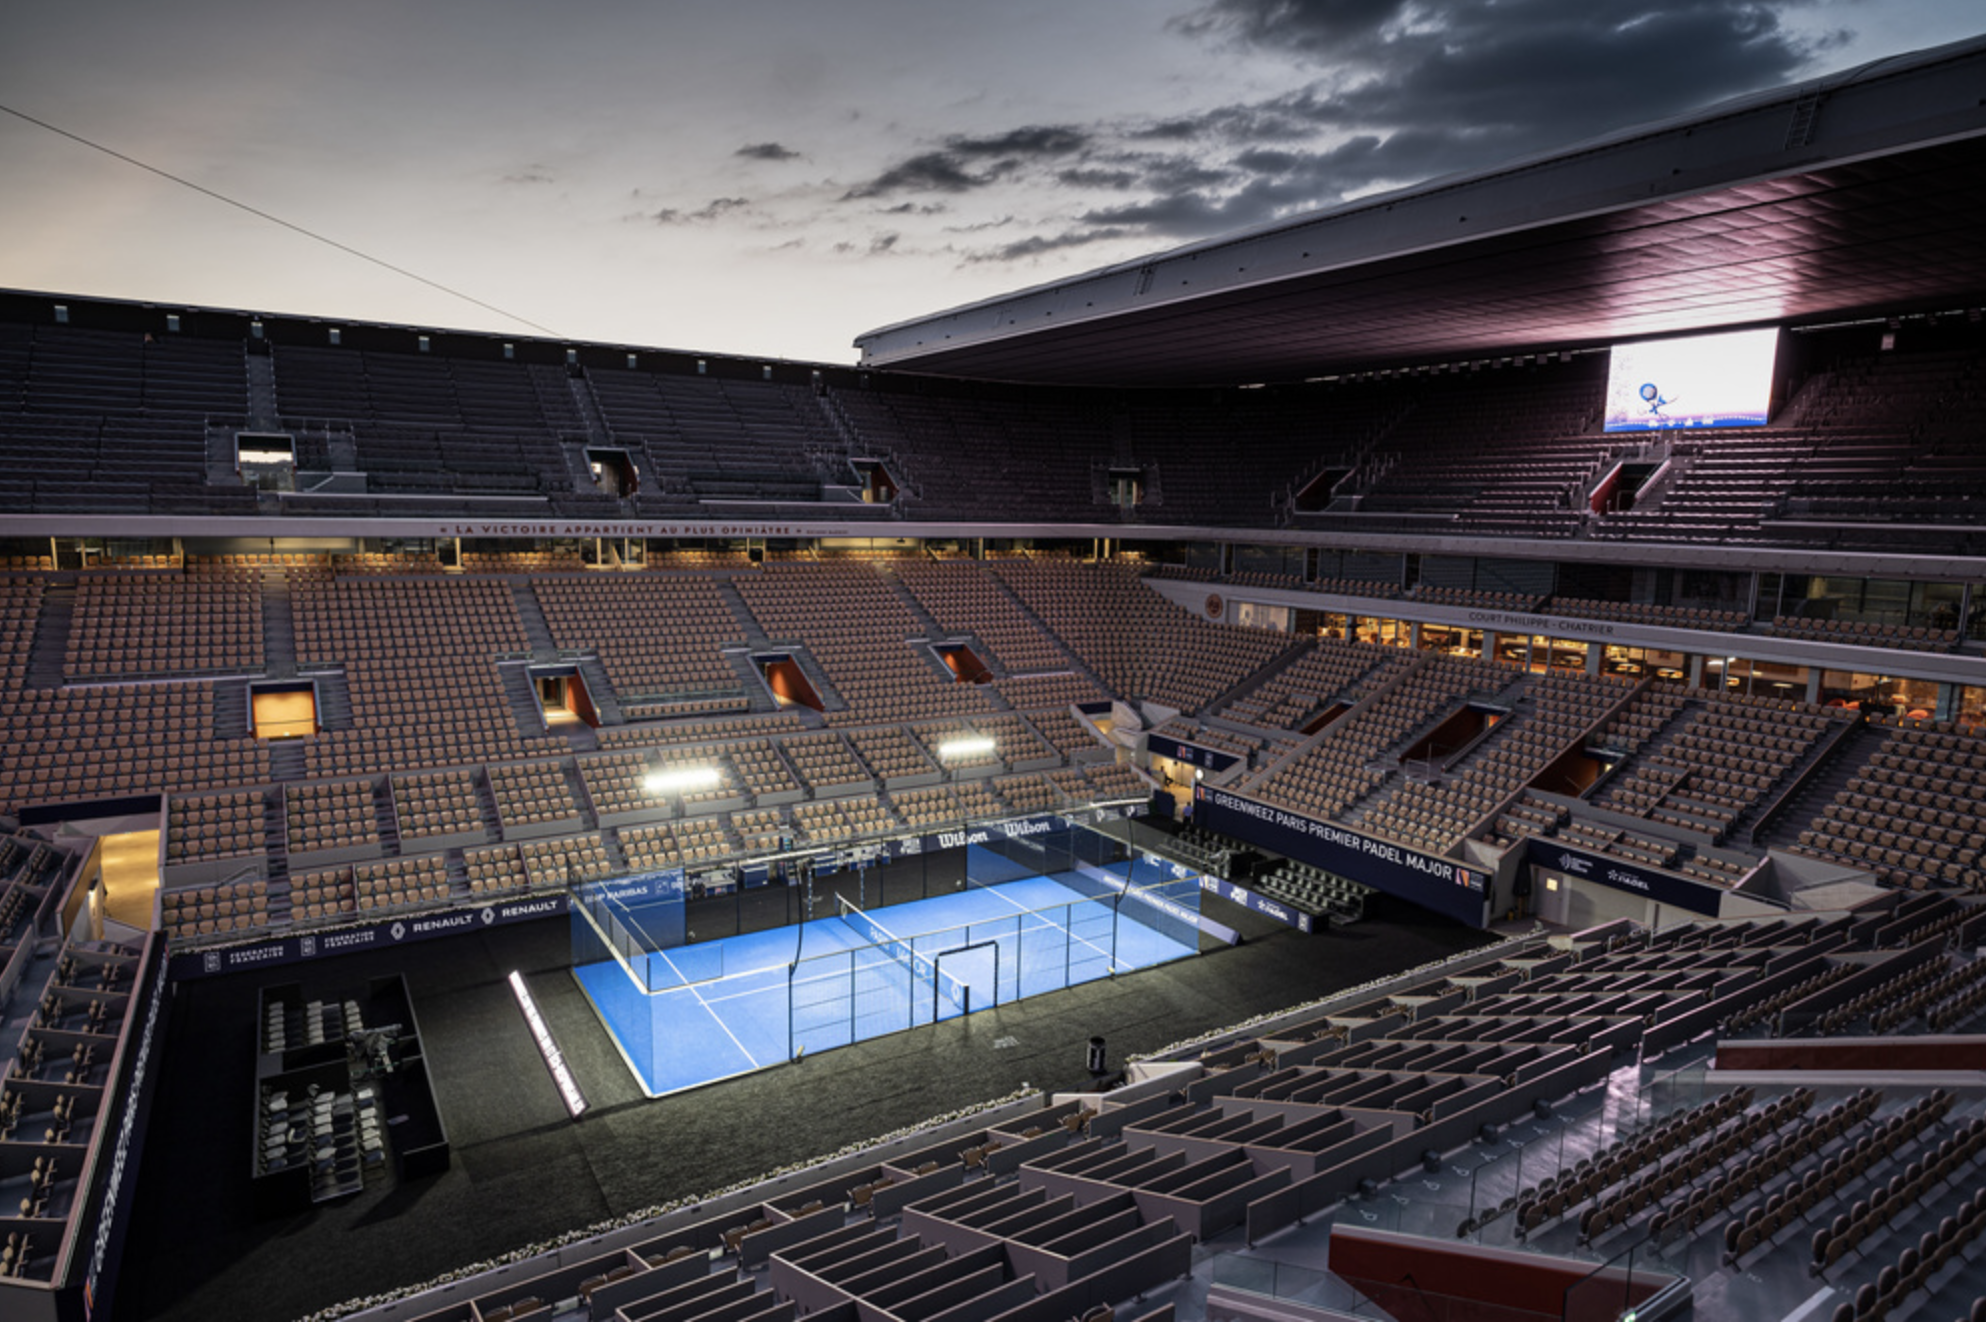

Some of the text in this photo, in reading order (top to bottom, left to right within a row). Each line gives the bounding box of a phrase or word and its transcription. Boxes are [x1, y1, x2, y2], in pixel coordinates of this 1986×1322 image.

[455, 525, 474, 534] LA
[481, 525, 556, 534] VICTOIRE
[564, 525, 653, 535] APPARTIENT
[660, 525, 678, 535] AU
[684, 525, 715, 535] PLUS
[1468, 611, 1501, 623] COURT
[1504, 614, 1549, 629] PHILIPPE
[1558, 620, 1614, 635] CHATRIER
[1004, 821, 1051, 837] Wilson
[1215, 793, 1274, 822] GREENWEEZ
[1276, 811, 1307, 833] PARIS
[1308, 822, 1361, 851] PREMIER
[1362, 839, 1403, 865] PADEL
[1405, 853, 1452, 880] MAJOR
[938, 831, 989, 849] Wilson
[501, 901, 558, 918] RENAULT
[412, 914, 474, 932] RENAULT
